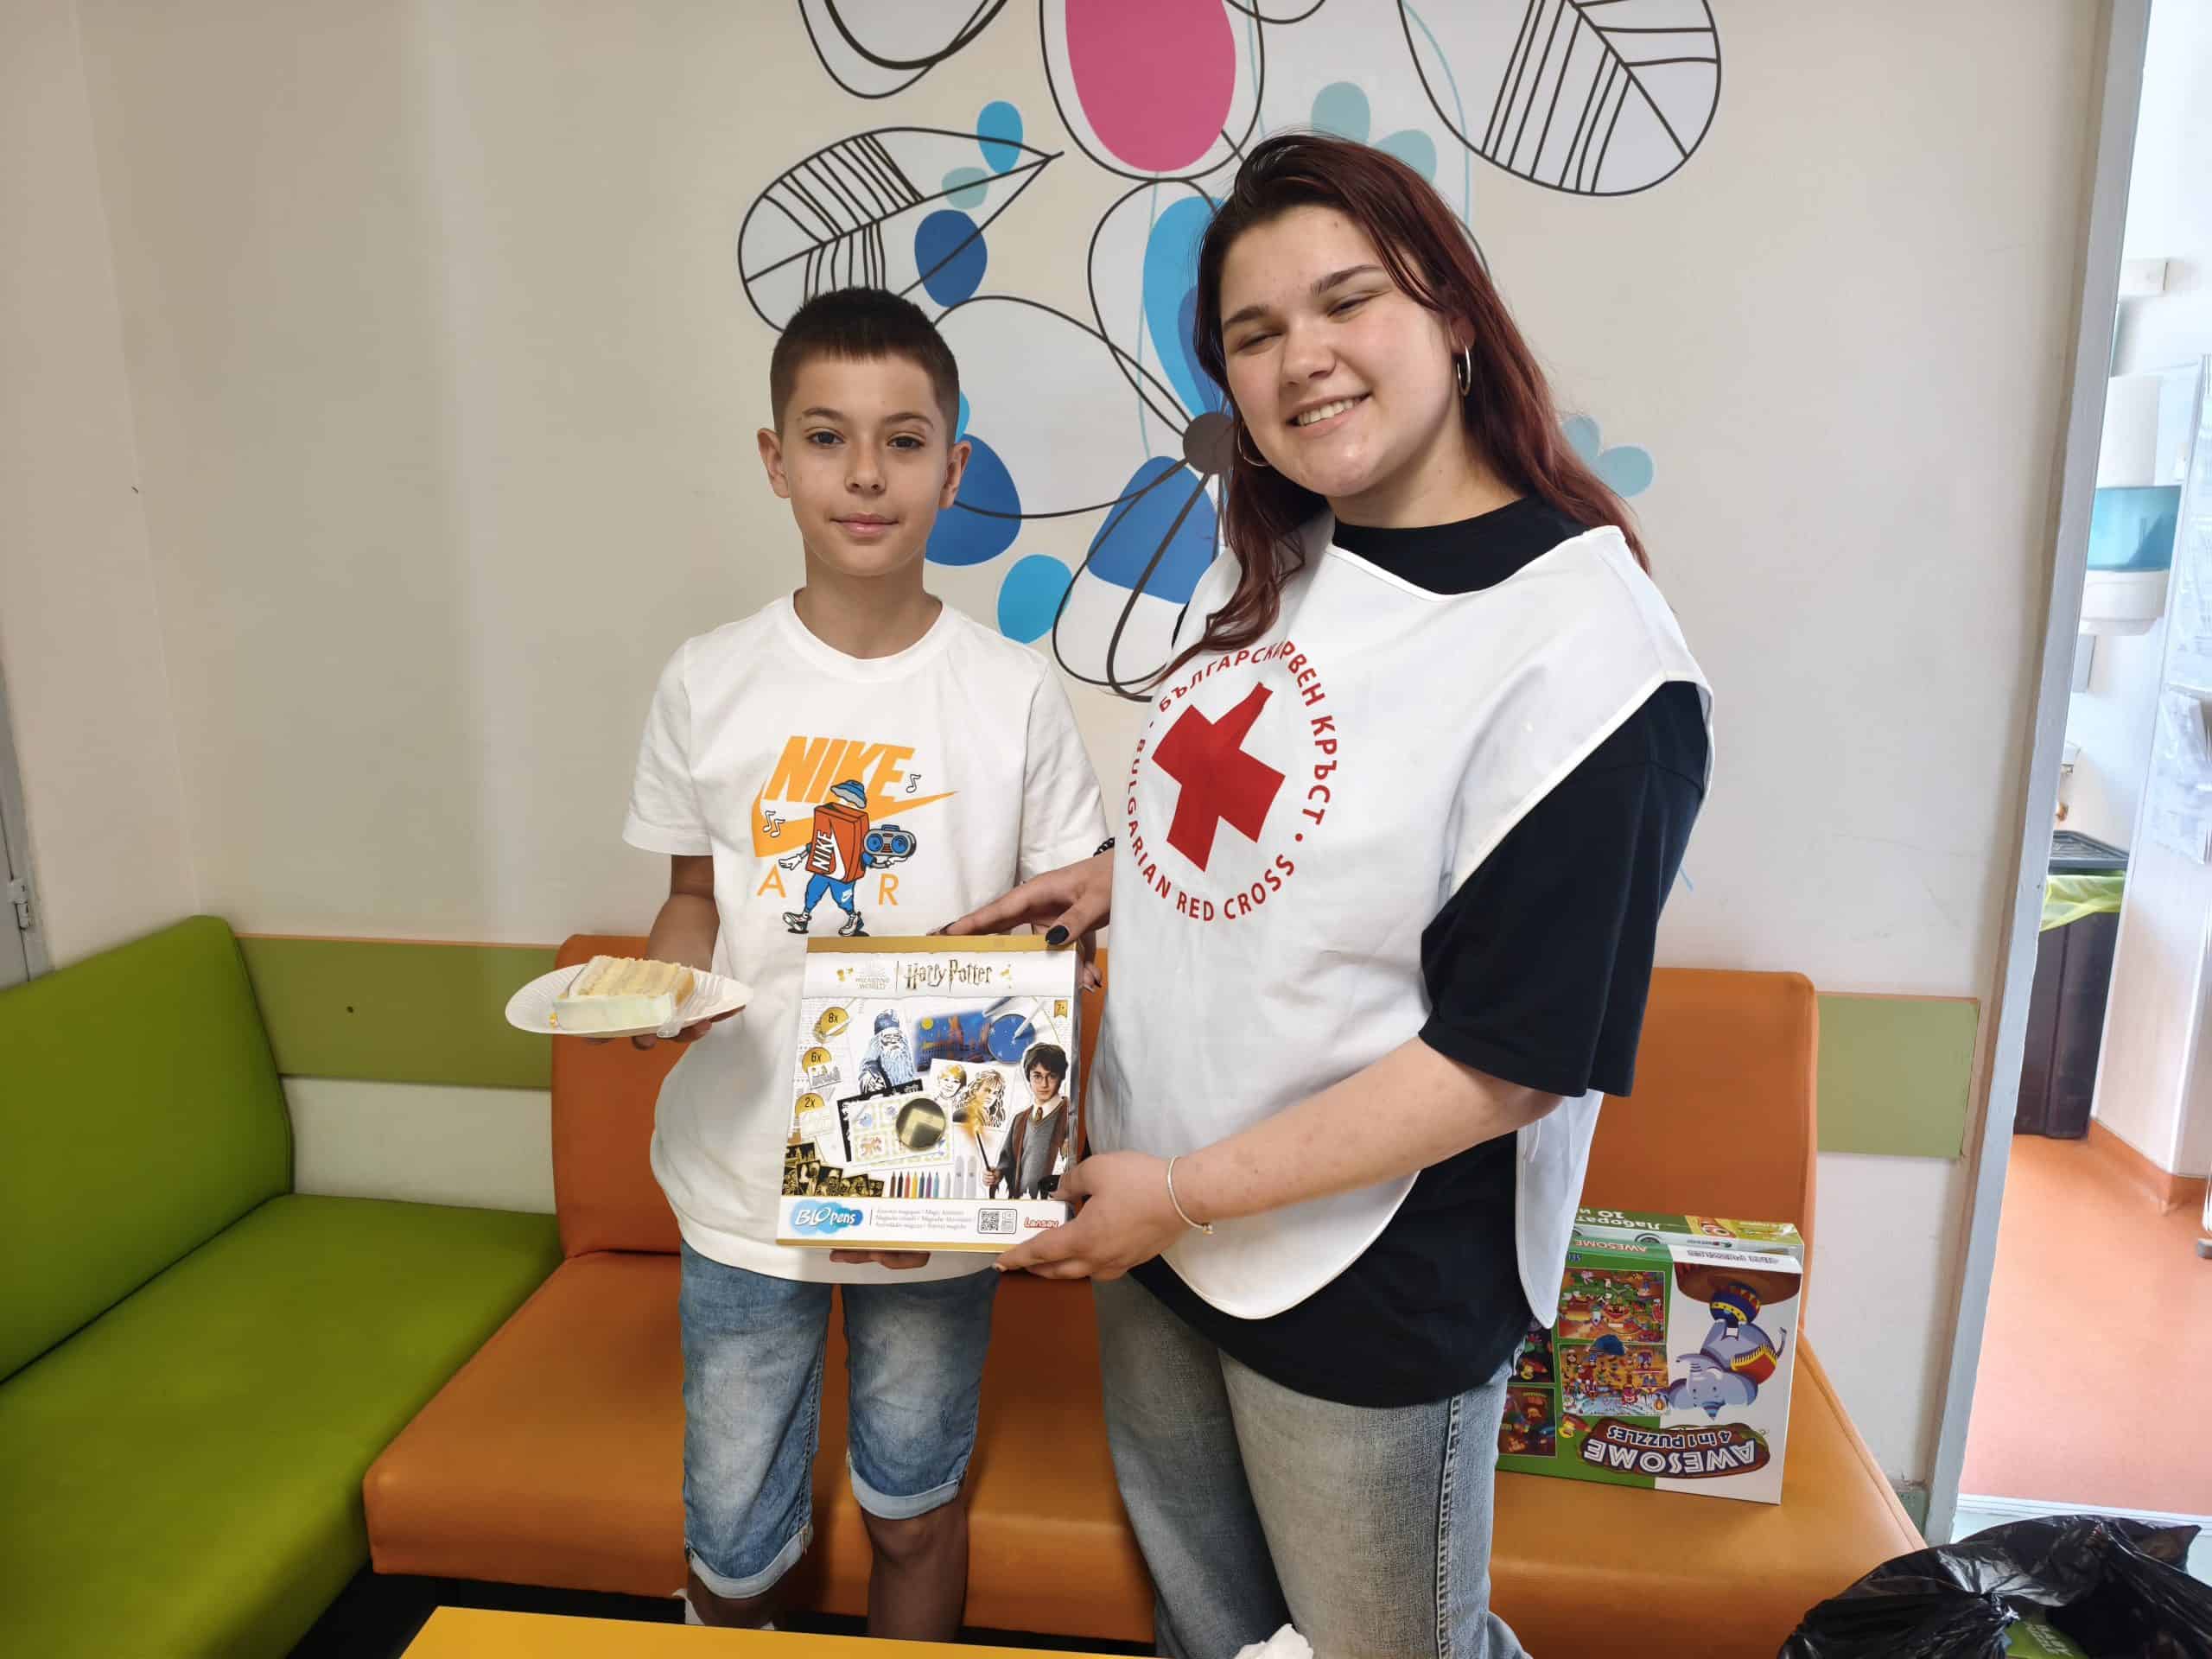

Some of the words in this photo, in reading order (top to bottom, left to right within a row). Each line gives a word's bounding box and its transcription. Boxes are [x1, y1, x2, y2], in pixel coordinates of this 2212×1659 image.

[764, 735, 915, 802] NIKE
[1303, 715, 1338, 825] КРЪСТ
[1126, 739, 1173, 899] BULGARIAN
[1177, 891, 1214, 922] RED
[1224, 854, 1294, 920] CROSS
[812, 830, 834, 871] NIKE
[905, 962, 947, 989] Harry
[949, 959, 993, 992] Potter
[828, 1013, 838, 1024] 8x
[810, 1052, 822, 1064] 6x
[804, 1097, 816, 1108] 2x
[1574, 1240, 1647, 1253] AWESOME
[1607, 1426, 1685, 1449] PUZZLES
[1719, 1430, 1732, 1444] 4
[1583, 1438, 1755, 1473] AWESOME
